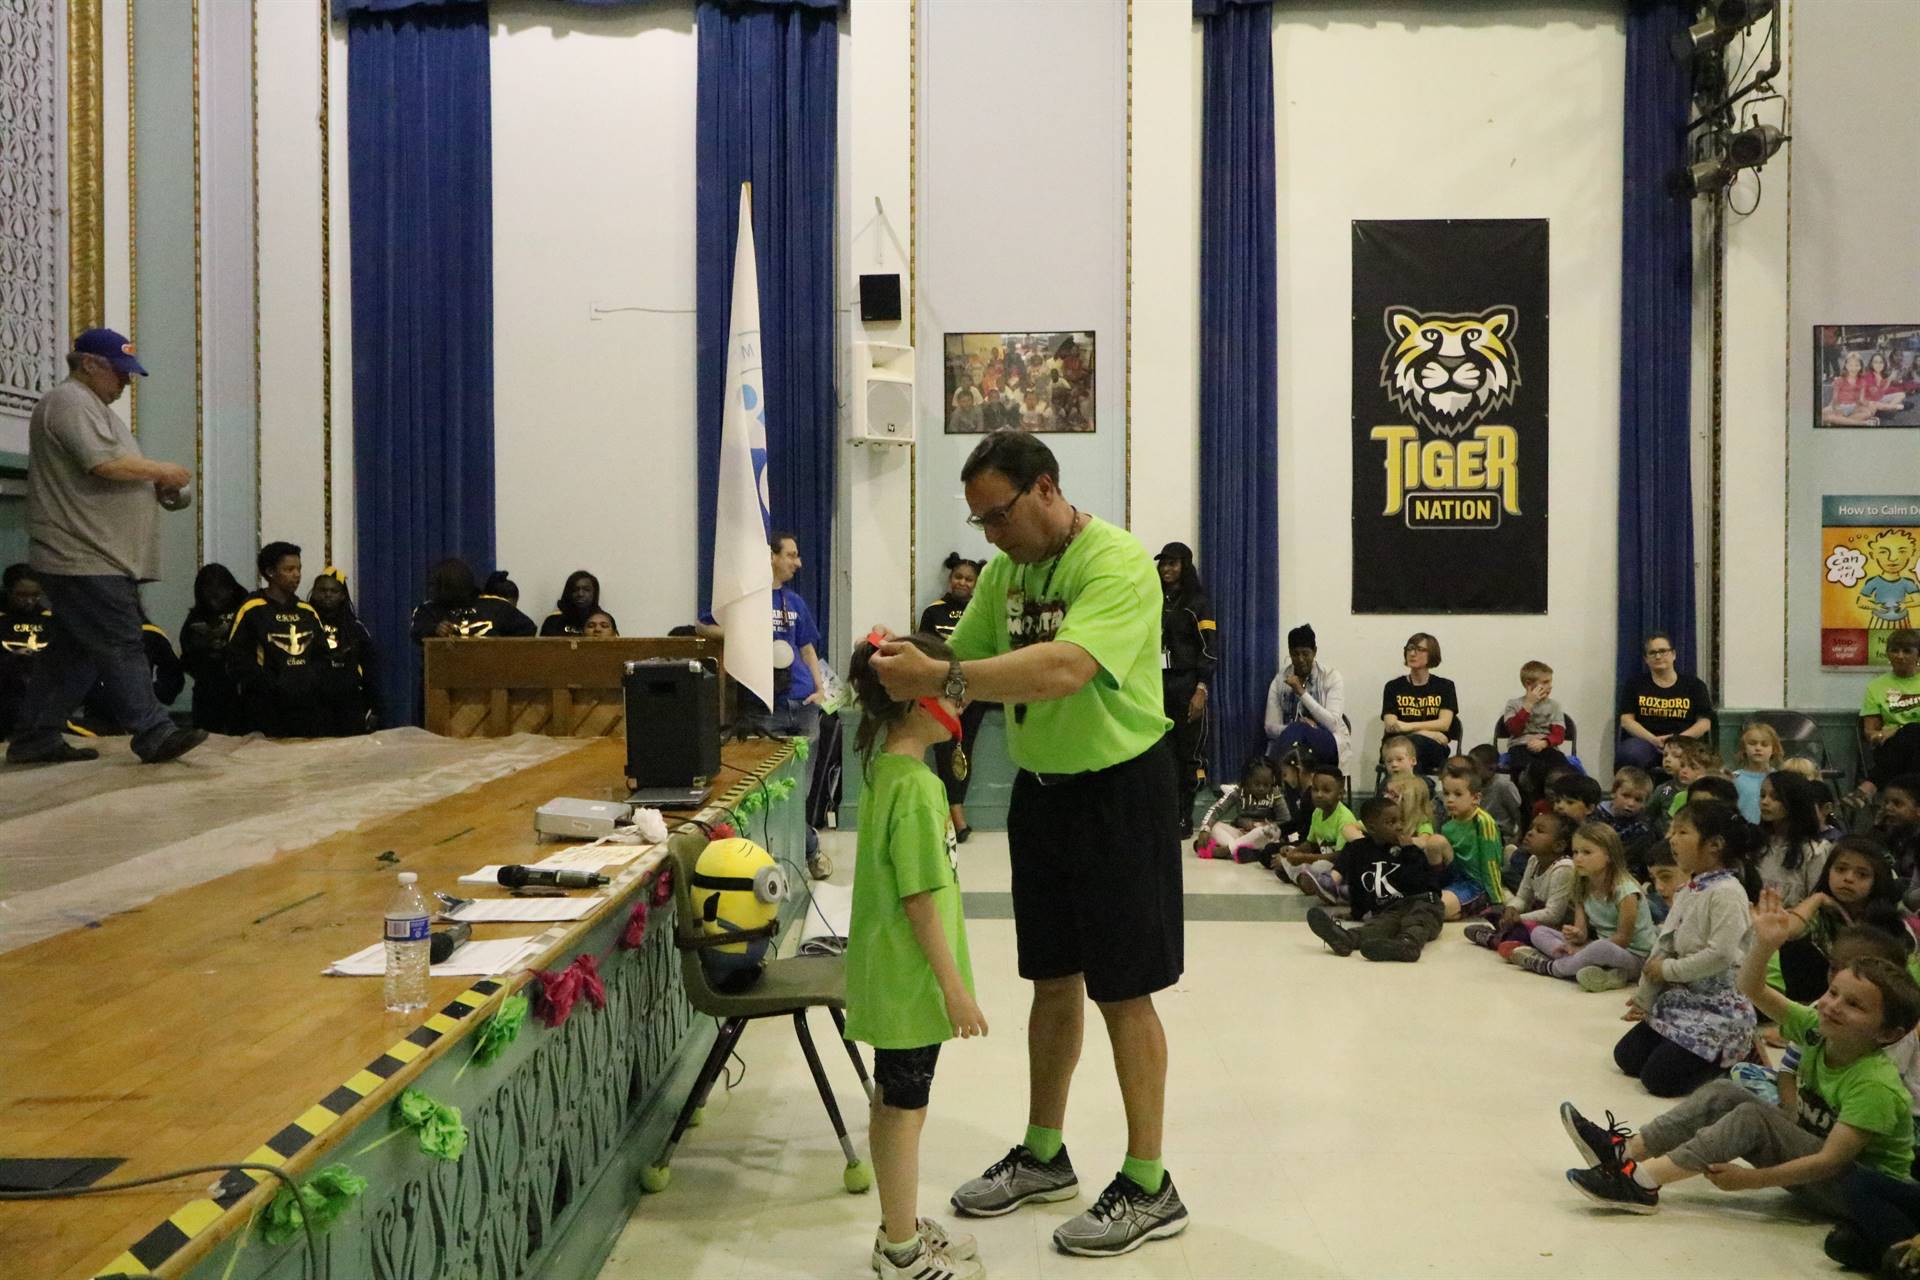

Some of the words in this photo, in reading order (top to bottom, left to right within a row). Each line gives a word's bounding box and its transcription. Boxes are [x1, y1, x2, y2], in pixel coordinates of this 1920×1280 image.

[1370, 425, 1521, 516] TIGER
[1415, 500, 1491, 520] NATION
[1839, 503, 1865, 515] How
[1867, 504, 1878, 515] to
[1881, 503, 1907, 515] Calm
[1638, 695, 1690, 710] ROXBORO
